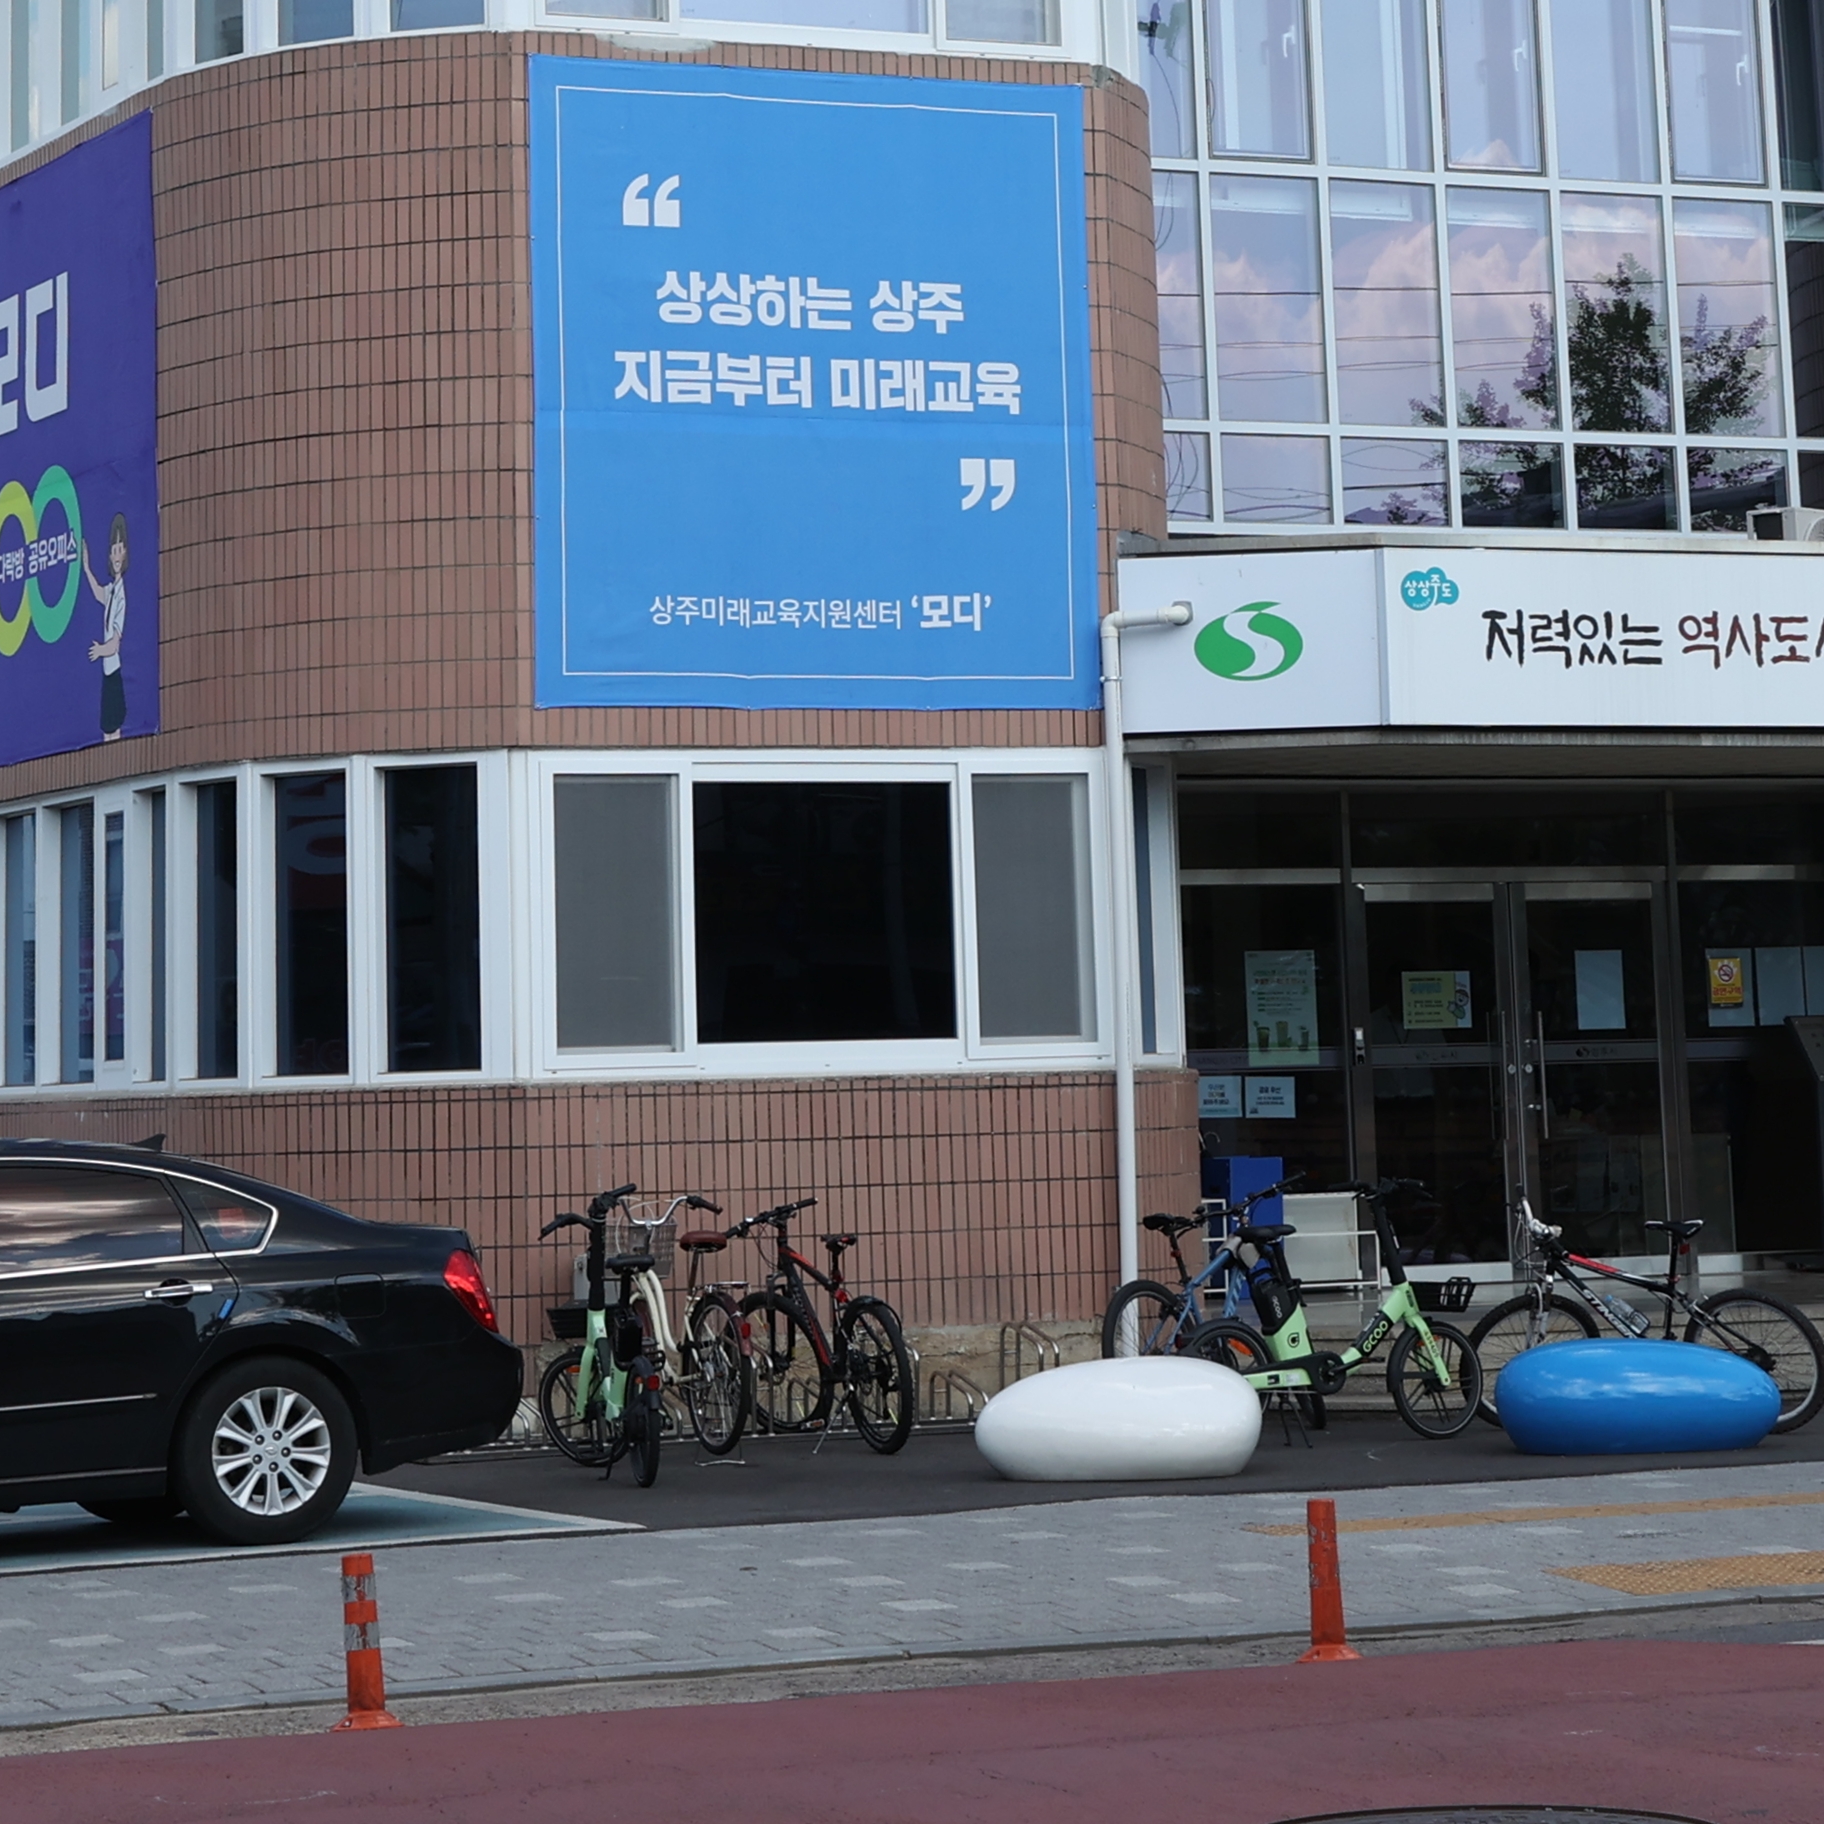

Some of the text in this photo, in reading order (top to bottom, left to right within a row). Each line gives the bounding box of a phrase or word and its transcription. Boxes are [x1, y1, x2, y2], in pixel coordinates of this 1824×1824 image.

[656, 270, 964, 334] 상상하는 상주
[614, 349, 1021, 415] 지금부터 미래교육
[28, 531, 78, 575] 공유오피스
[648, 594, 901, 630] 상주미래교육지원센터
[1482, 609, 1663, 669] 저력있는
[1363, 1320, 1388, 1353] GCOO
